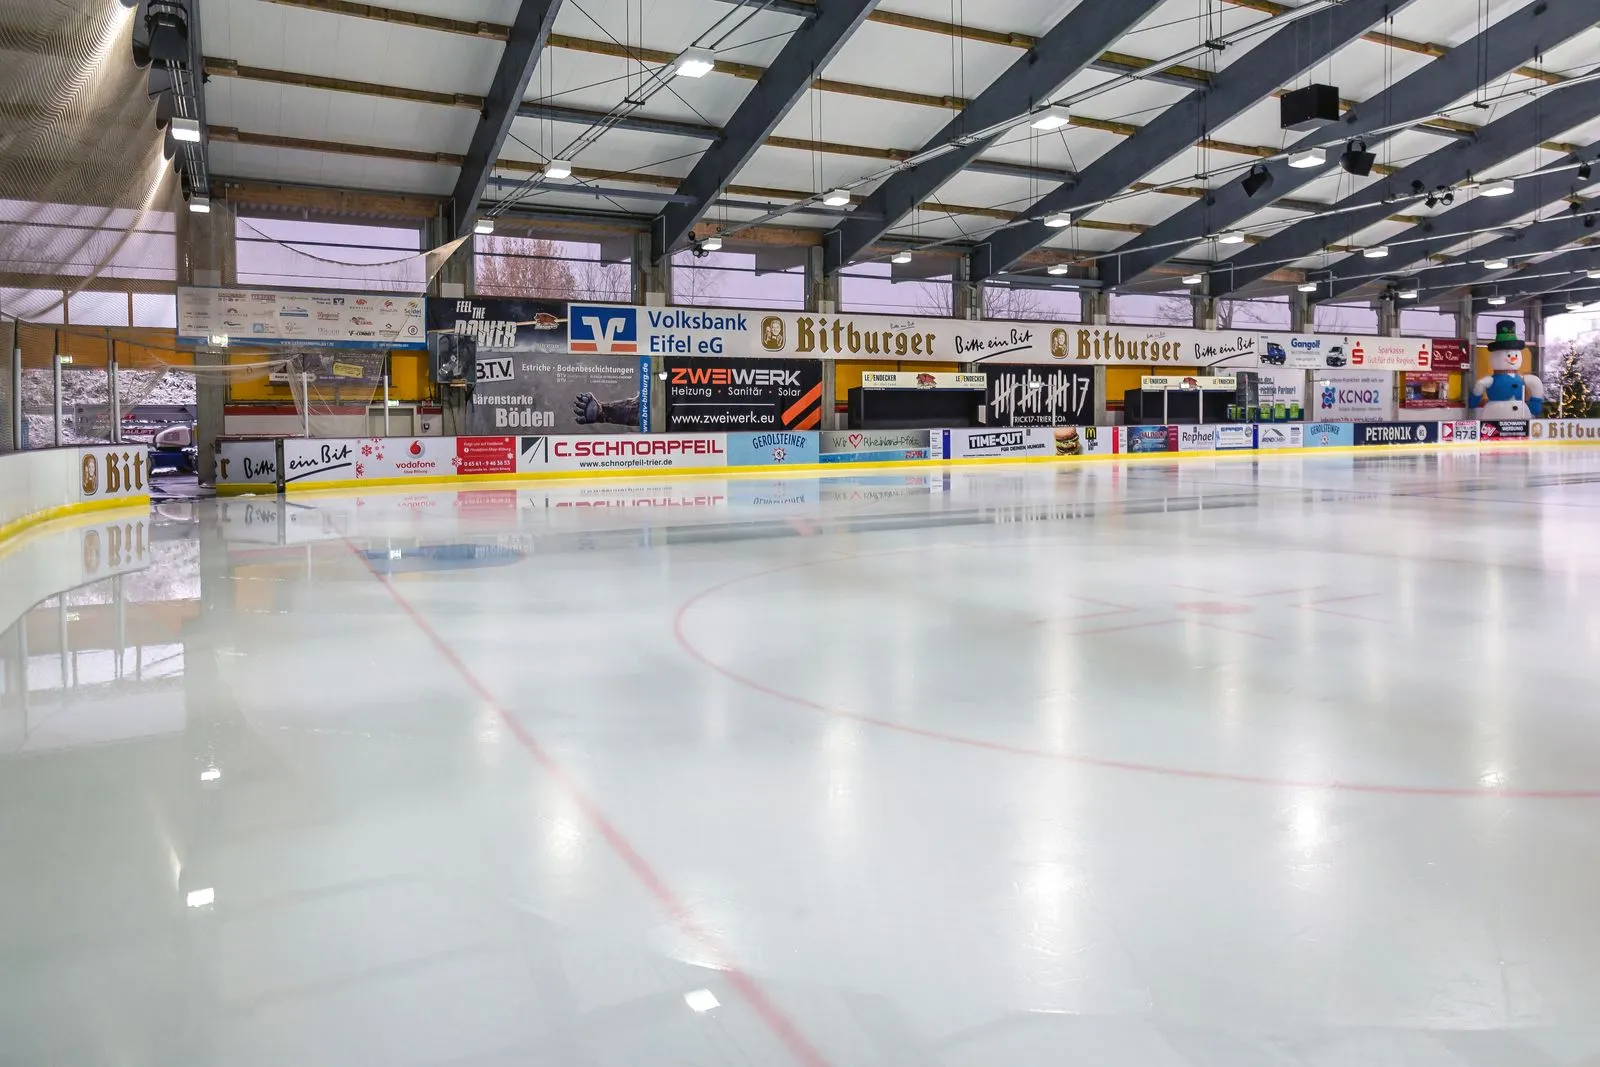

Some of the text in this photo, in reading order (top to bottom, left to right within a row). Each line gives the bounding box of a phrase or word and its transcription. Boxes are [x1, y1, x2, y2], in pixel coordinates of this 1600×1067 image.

[456, 300, 472, 313] FEEL
[472, 307, 486, 319] THE
[648, 310, 748, 331] Volksbank
[795, 316, 936, 356] Bitburger
[955, 328, 1033, 354] Bitte ein Bit
[650, 335, 723, 353] Eifel eG
[1076, 329, 1181, 362] Bitburger
[1194, 337, 1255, 360] Bitte ein Bit
[1291, 338, 1320, 350] Gangolf
[1378, 346, 1405, 355] Sparkasse
[522, 363, 634, 375] Estriche Bodenbeschichtungen
[671, 368, 801, 386] ZWEIWERK
[671, 386, 800, 398] Heizung Sanitär Solar
[1339, 390, 1379, 404] KCNQ2
[495, 408, 555, 428] Böden
[671, 411, 775, 424] www.zweiwerk.eu
[1310, 424, 1340, 436] GEROLSTEINER
[1455, 430, 1477, 440] 87.8
[752, 433, 806, 449] GEROLSTEINER
[833, 438, 848, 448] Wir
[969, 431, 1023, 449] TIME-OUT
[1182, 431, 1214, 445] Raphael
[243, 457, 276, 479] Bitte
[289, 456, 318, 470] ein
[321, 444, 352, 463] Bit
[396, 461, 436, 469] vodafone
[579, 459, 673, 468] www.schnorpfeil-trier.de
[105, 451, 150, 494] Bit
